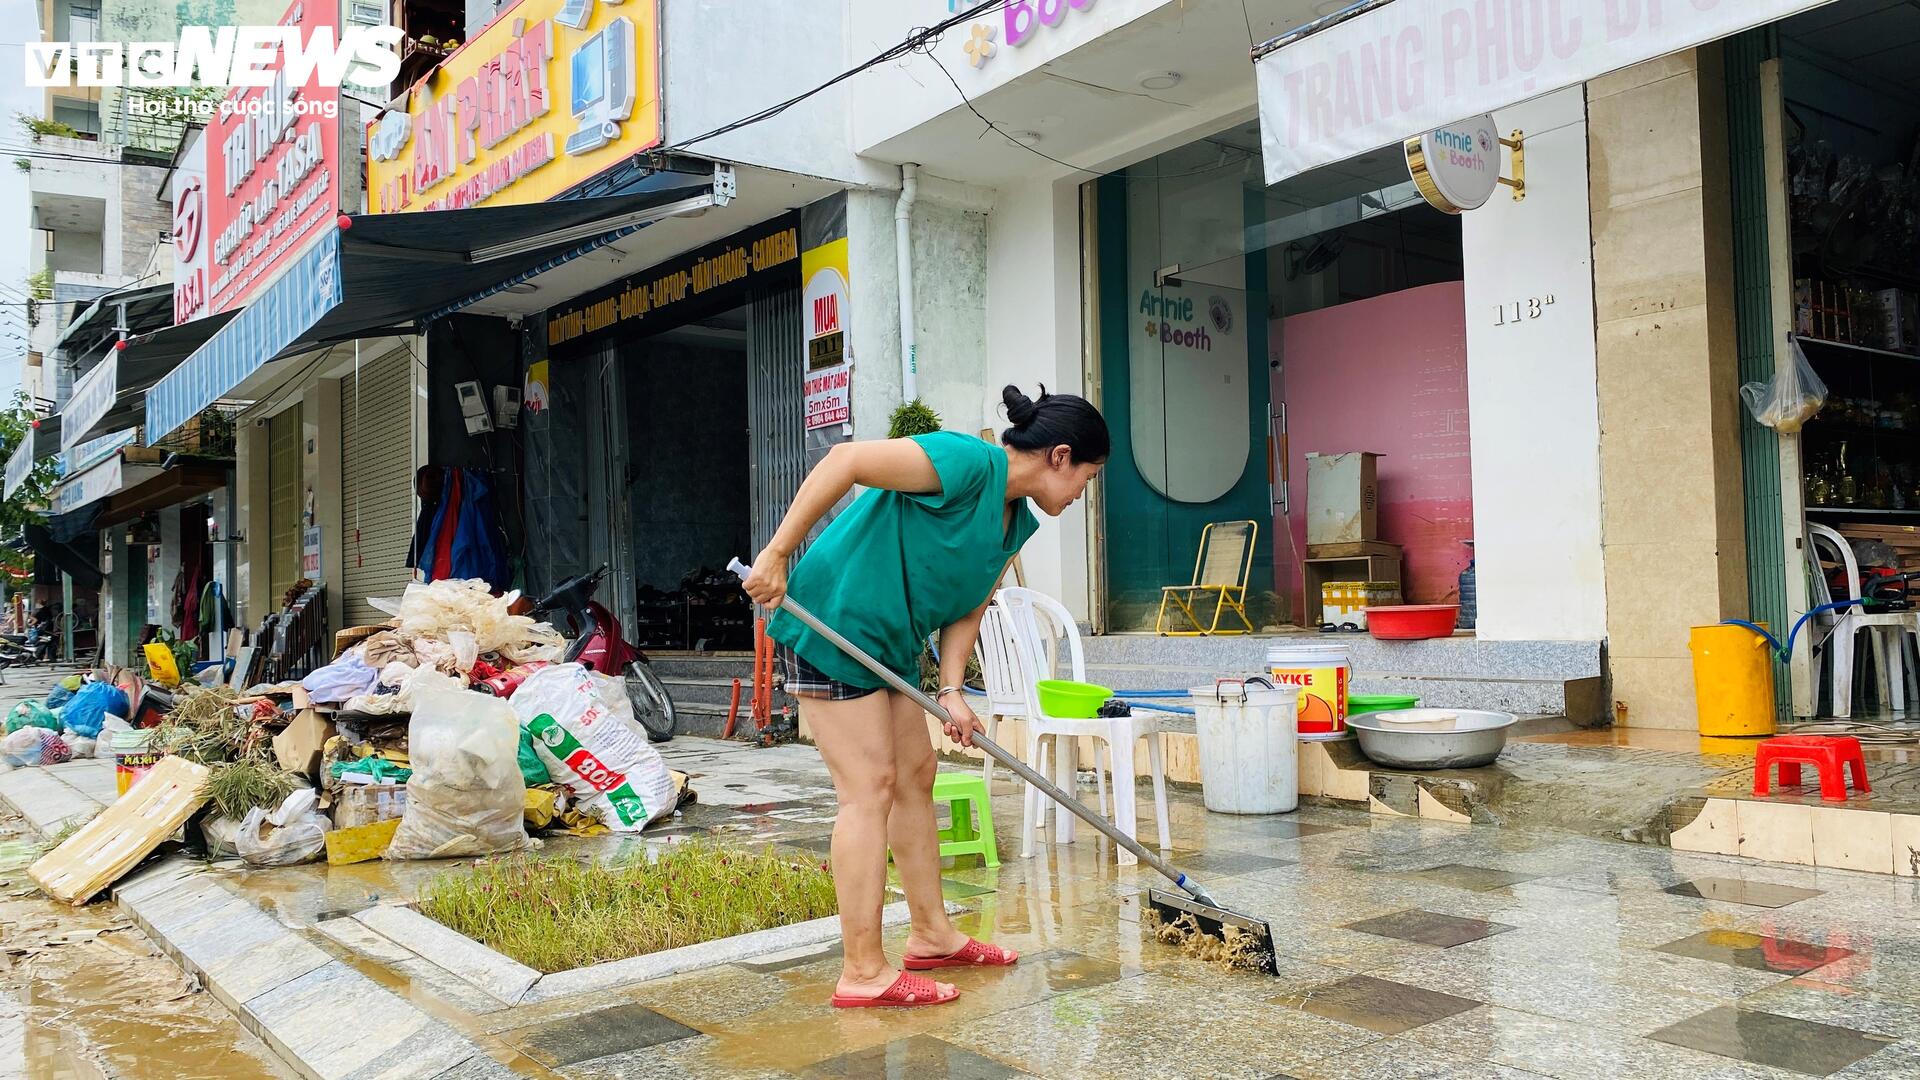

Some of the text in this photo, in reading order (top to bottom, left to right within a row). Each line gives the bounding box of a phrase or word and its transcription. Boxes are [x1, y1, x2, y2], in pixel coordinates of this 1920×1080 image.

[1283, 24, 1425, 150] TRANG
[1434, 128, 1473, 152] Annie
[1450, 149, 1485, 172] Booth
[653, 271, 687, 309] LAPTOP
[752, 227, 798, 272] CAMERA
[814, 293, 838, 334] MUA
[1139, 288, 1194, 322] Annie
[1160, 321, 1212, 352] Booth
